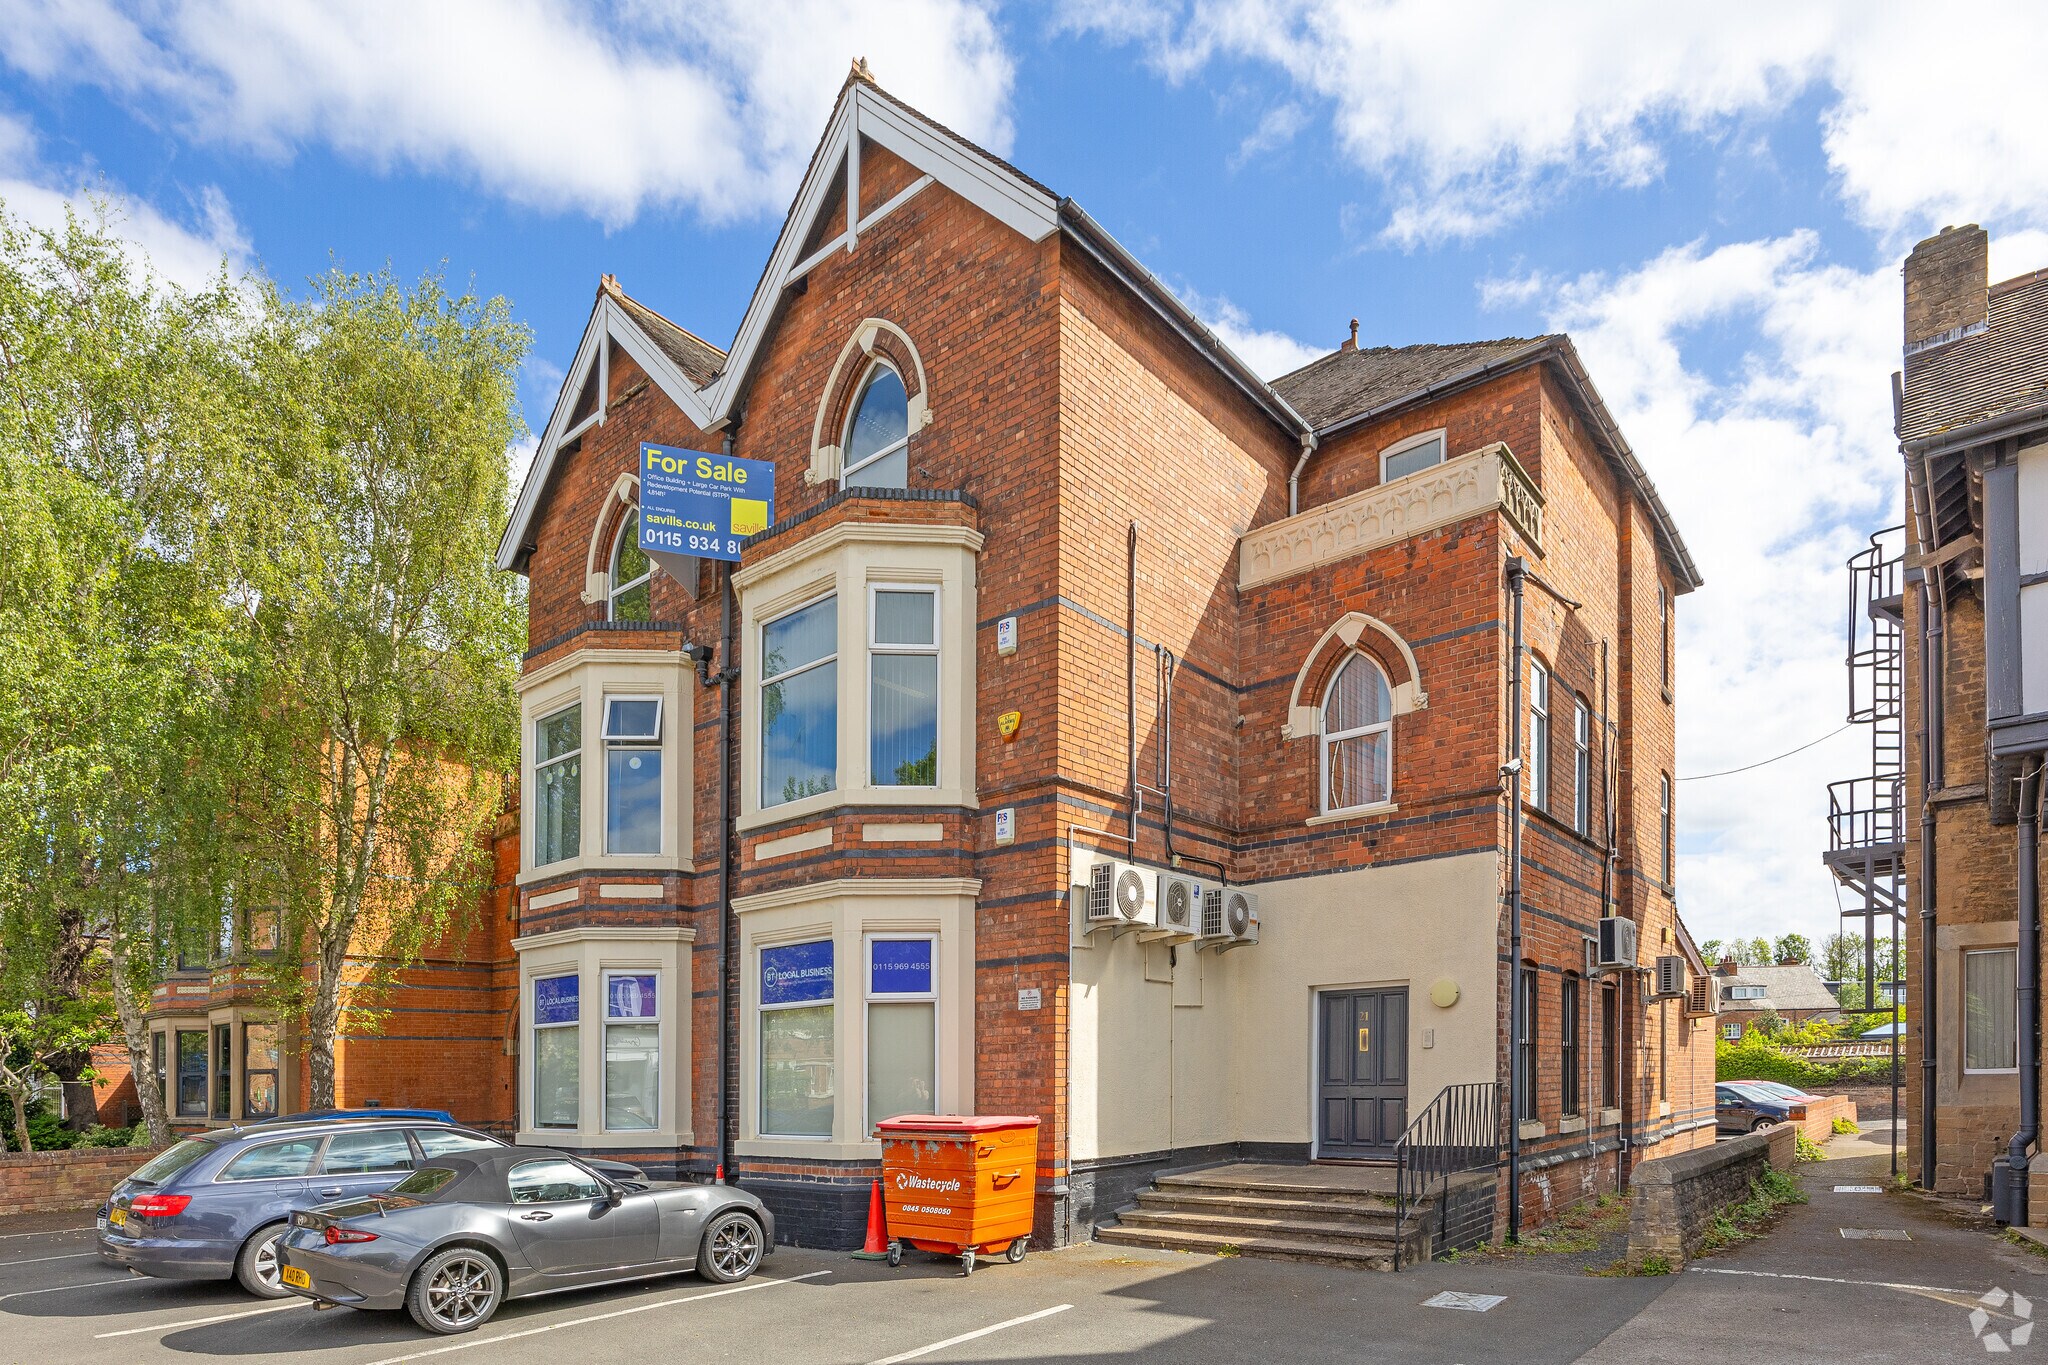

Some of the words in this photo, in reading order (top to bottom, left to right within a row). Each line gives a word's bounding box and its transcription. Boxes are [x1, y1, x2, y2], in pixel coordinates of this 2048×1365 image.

[647, 449, 687, 475] For
[696, 457, 748, 484] Sale
[647, 474, 664, 482] Office
[666, 477, 686, 486] Building
[692, 481, 708, 489] Large
[647, 481, 687, 493] Redevelopment
[689, 488, 711, 497] Potential
[712, 491, 730, 500] (STPP)
[646, 513, 716, 532] savills.co.uk
[646, 529, 682, 547] 0115
[689, 535, 720, 552] 934
[727, 540, 741, 554] 8
[778, 971, 799, 980] LOCAL
[801, 966, 832, 977] BUSINESS
[910, 962, 930, 970] 4555
[547, 997, 560, 1006] LOCAL
[909, 1175, 960, 1192] Wastecycle
[921, 1206, 951, 1215] 0508050
